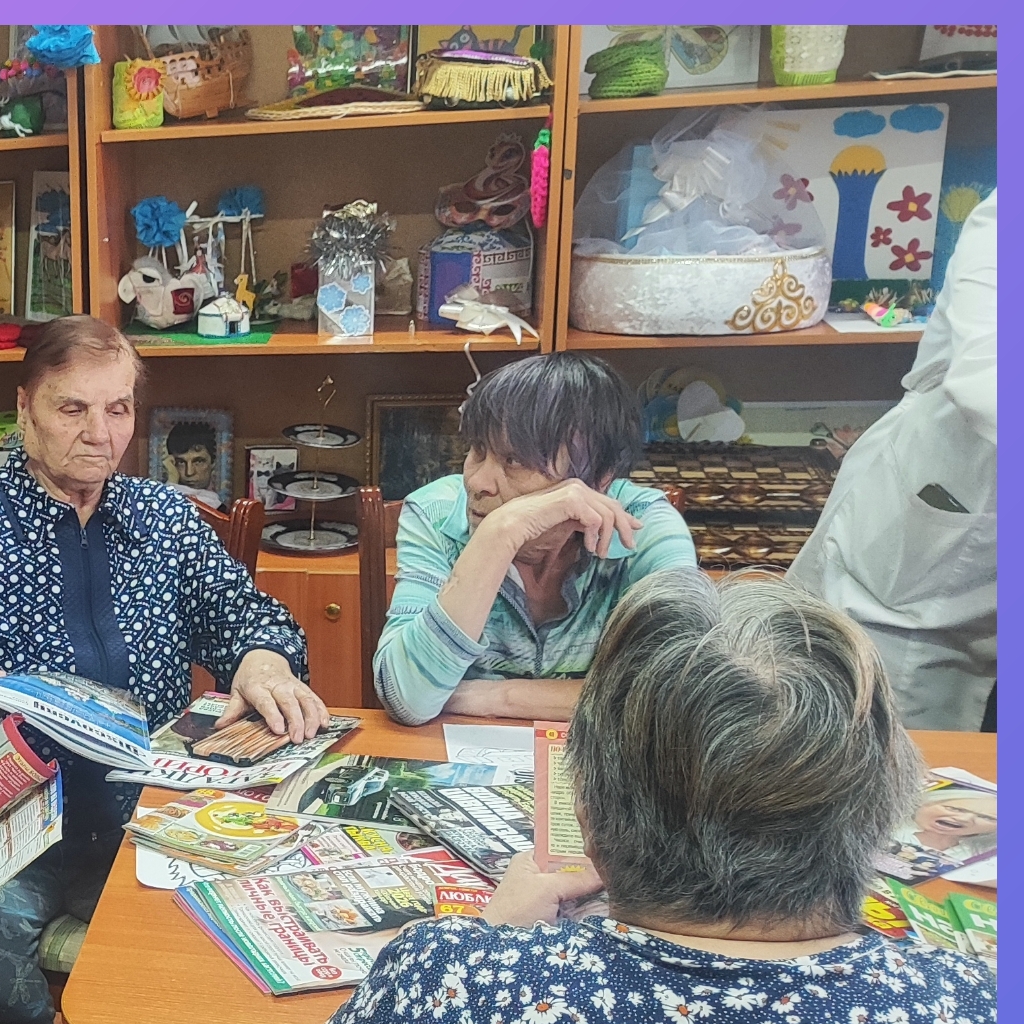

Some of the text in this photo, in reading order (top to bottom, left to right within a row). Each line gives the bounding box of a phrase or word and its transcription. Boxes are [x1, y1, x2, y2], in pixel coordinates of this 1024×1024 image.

[237, 879, 276, 926] личные
[268, 920, 315, 966] границы
[252, 876, 276, 896] Как
[269, 892, 330, 964] выстраивать
